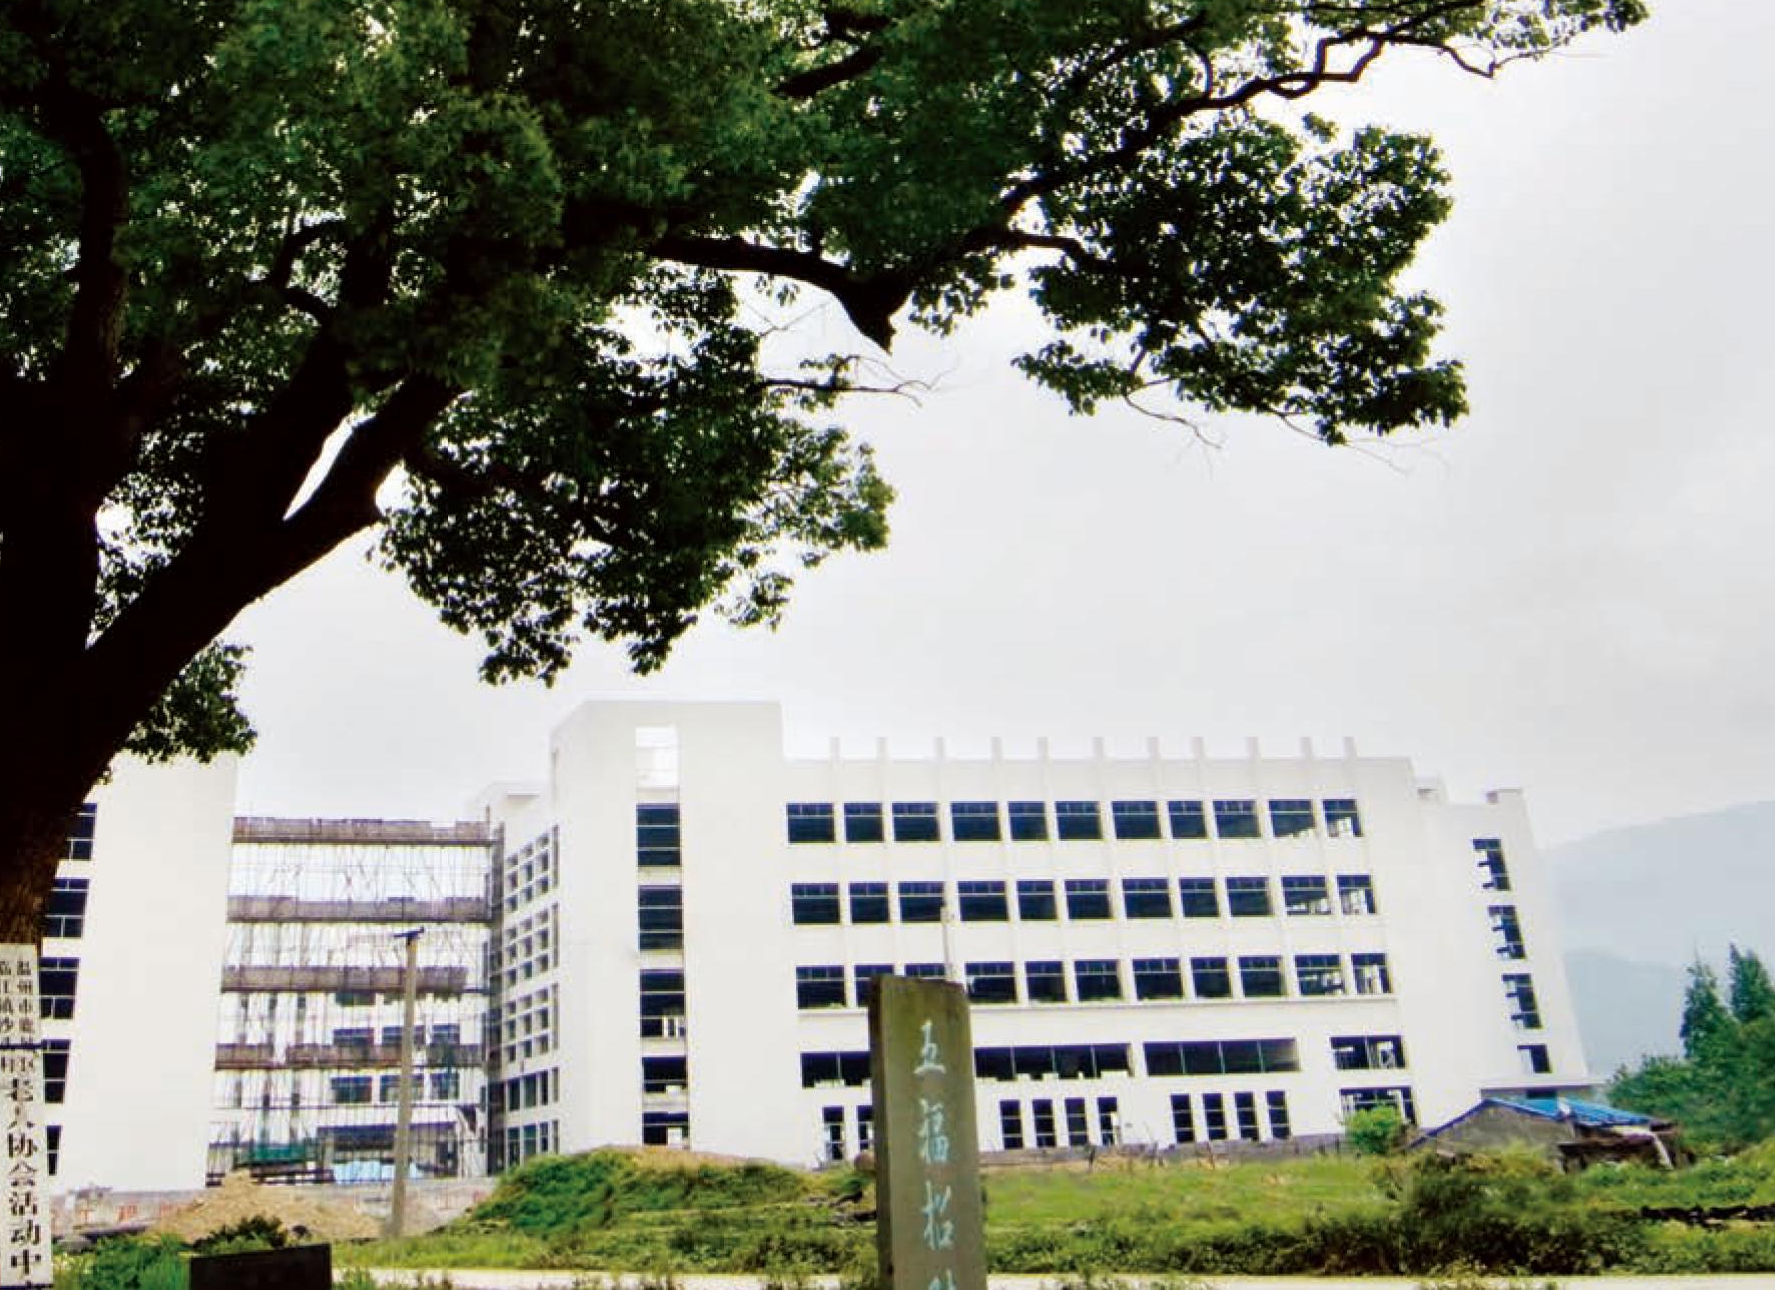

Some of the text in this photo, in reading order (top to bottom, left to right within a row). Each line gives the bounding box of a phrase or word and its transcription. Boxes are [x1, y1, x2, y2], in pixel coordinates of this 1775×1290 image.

[7, 1077, 42, 1290] 老人协会活动中
